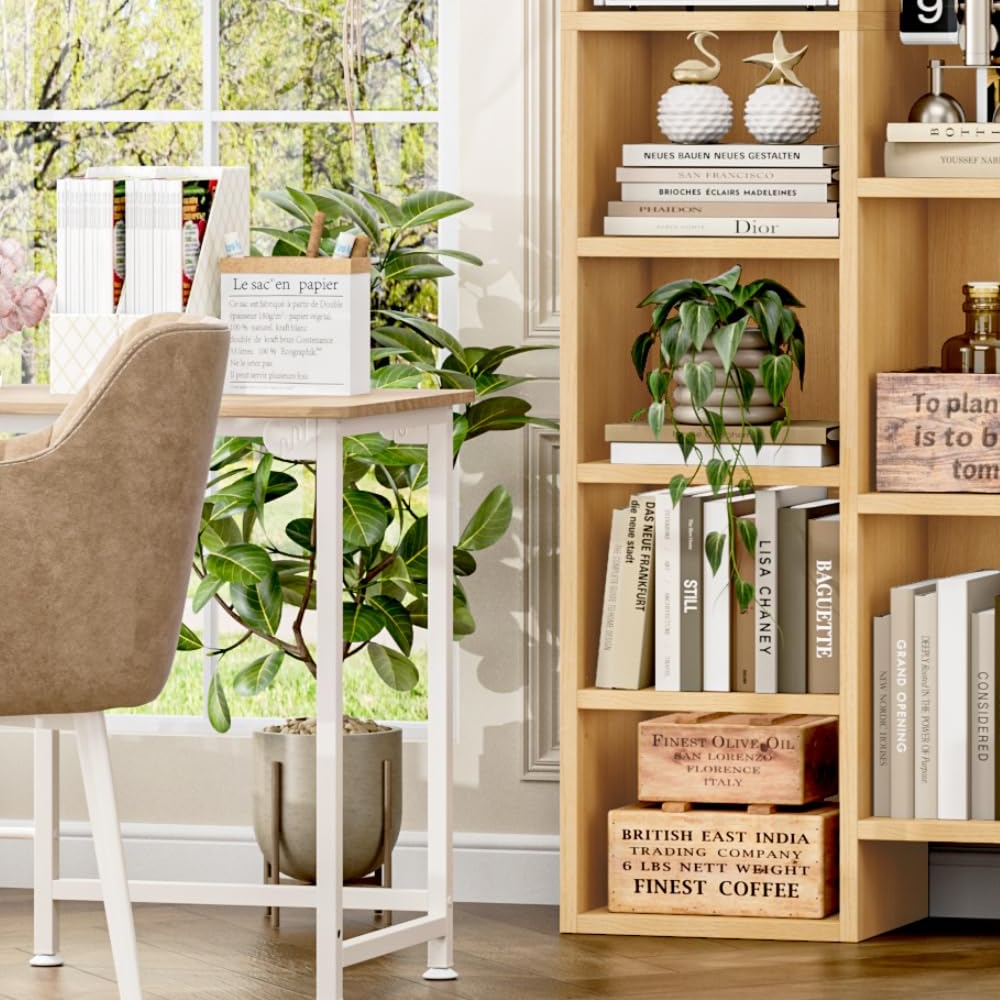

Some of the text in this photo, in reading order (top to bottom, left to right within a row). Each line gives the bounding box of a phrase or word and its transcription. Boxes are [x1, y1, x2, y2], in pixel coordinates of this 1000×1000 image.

[643, 152, 801, 160] NEUES BAUEN NEUES GESTALTEN
[677, 171, 775, 179] SAN FRANCISCO
[658, 187, 797, 197] BRIOCHES ÉCLAIRS MADELEINES
[735, 219, 780, 234] Dior
[233, 278, 248, 291] Le
[275, 281, 290, 290] en
[298, 278, 339, 294] papier
[912, 392, 939, 413] To
[914, 425, 936, 447] is
[944, 427, 973, 448] to
[625, 500, 640, 564] die neue stadt
[635, 501, 655, 612] DAS NEUE FRANKFURT
[683, 579, 698, 613] STILL
[759, 540, 772, 656] LISA CHANEY
[815, 560, 833, 658] BAGUETTE
[896, 639, 907, 753] GRAND OPENING
[921, 699, 930, 713] THE
[879, 670, 888, 767] NEW NORDIC HOUSES
[977, 671, 989, 762] CONSIDERED
[921, 715, 930, 744] POWER
[673, 752, 773, 762] SAN LORENZO
[686, 765, 761, 775] FLORENCE
[703, 778, 743, 788] ITALY
[622, 829, 810, 845] BRITISH EAST INDIA
[629, 846, 803, 860] TRADING COMPANY
[622, 861, 811, 876] 6 LBS NETT WEIGHT
[634, 878, 800, 899] FINEST COFFEE
